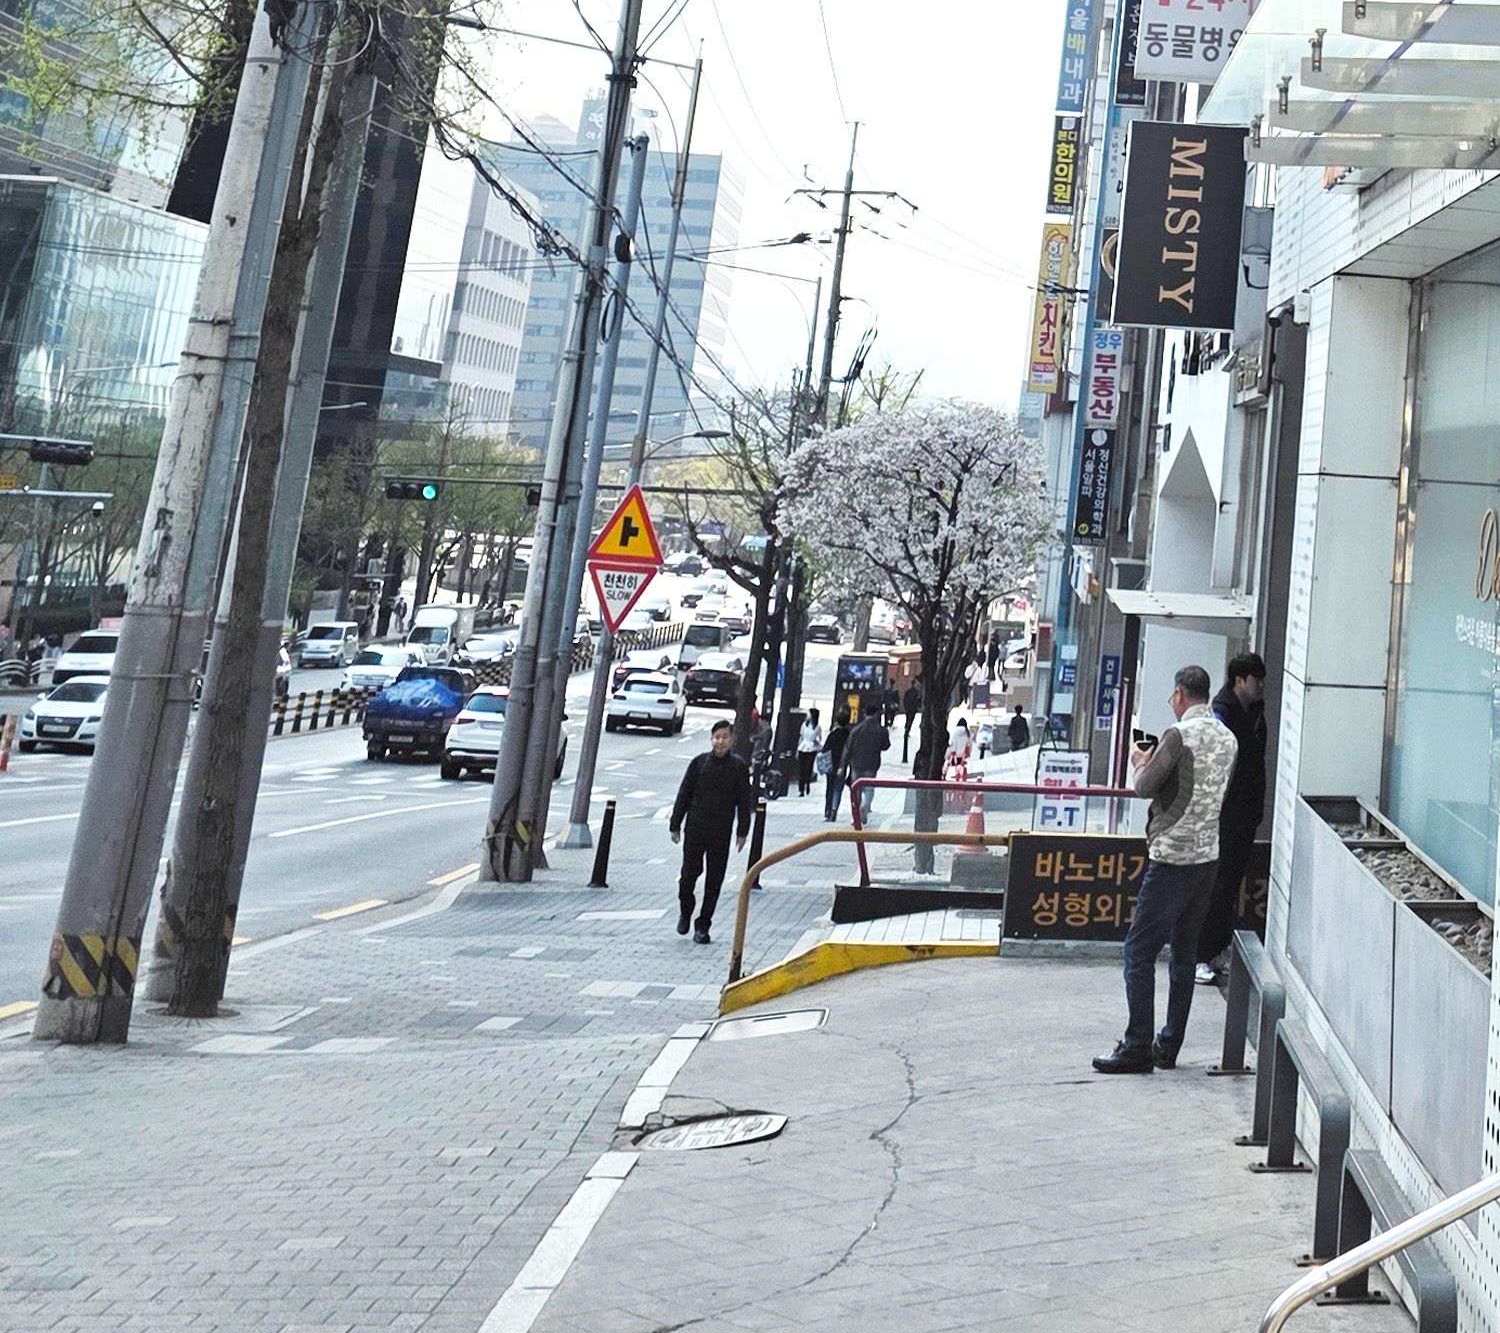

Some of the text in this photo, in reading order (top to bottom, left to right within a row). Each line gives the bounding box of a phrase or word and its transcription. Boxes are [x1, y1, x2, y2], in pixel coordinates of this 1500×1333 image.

[1158, 137, 1208, 313] MISTY
[1039, 302, 1059, 357] 치킨
[1095, 333, 1121, 349] 정우
[1088, 353, 1117, 420] 부동산
[604, 573, 638, 590] 천천히
[606, 589, 632, 600] SLOW
[1041, 806, 1080, 826] P.T
